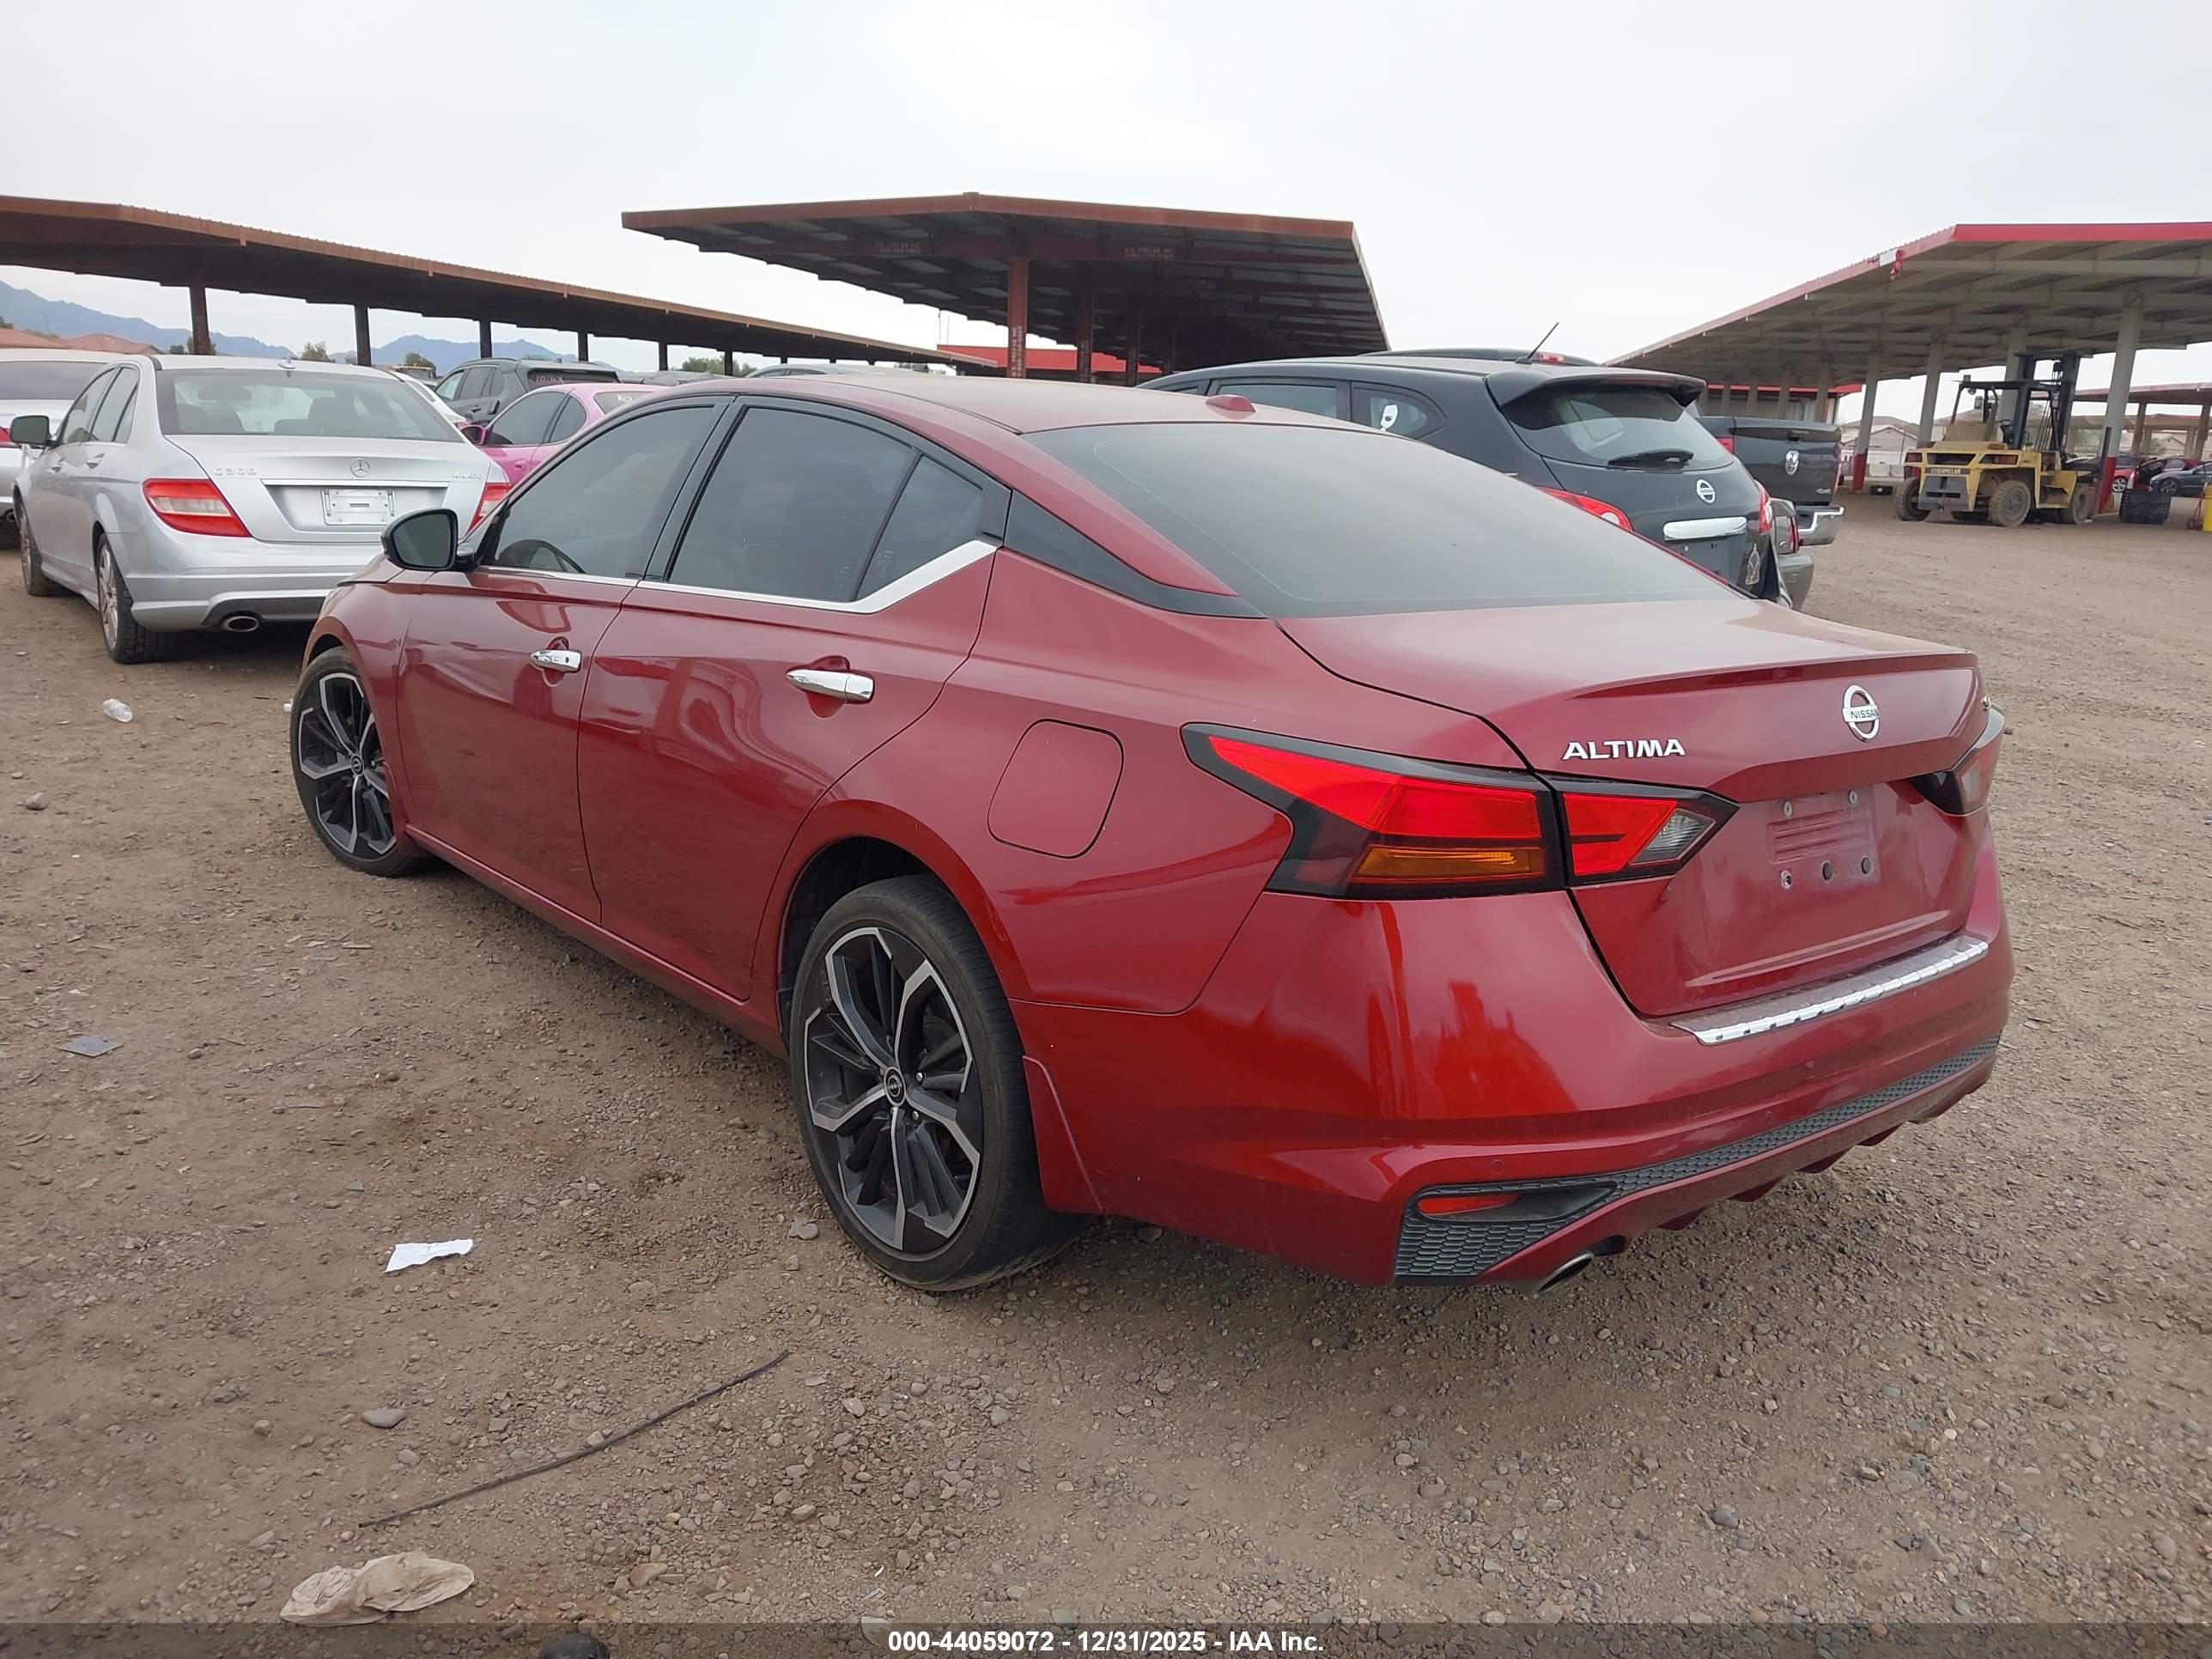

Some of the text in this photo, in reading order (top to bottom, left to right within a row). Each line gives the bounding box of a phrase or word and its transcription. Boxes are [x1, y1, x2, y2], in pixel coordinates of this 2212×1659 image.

[226, 467, 257, 476] 300
[1850, 708, 1879, 720] NISSAN
[1562, 738, 1686, 761] ALTIMA
